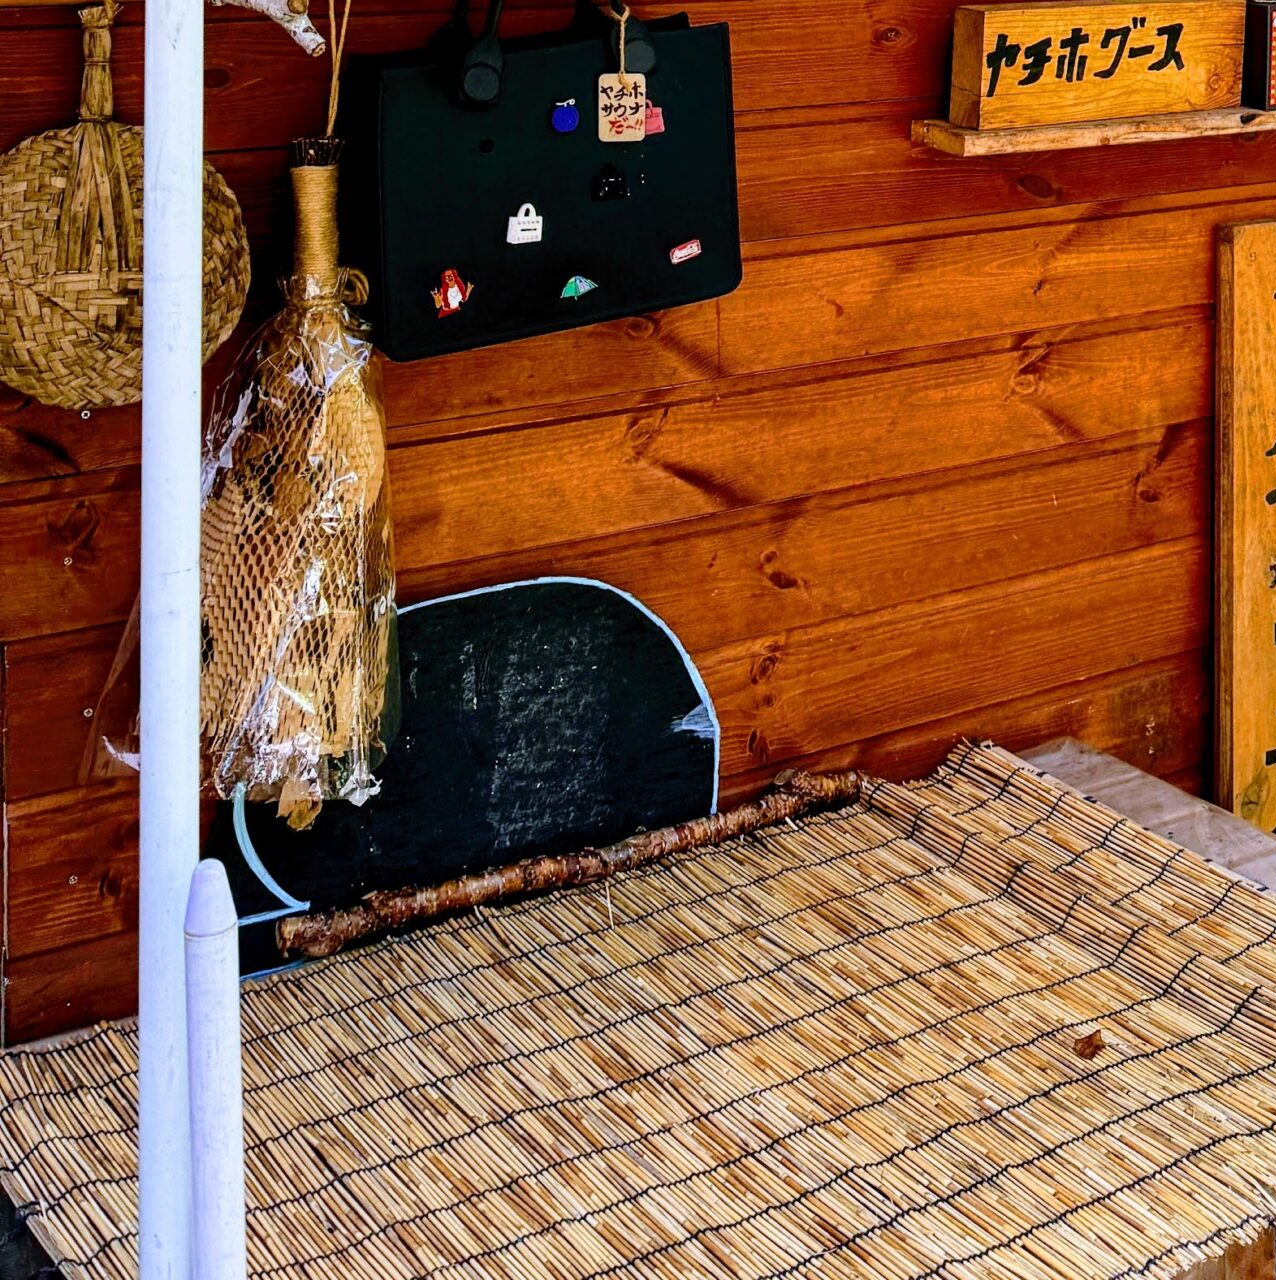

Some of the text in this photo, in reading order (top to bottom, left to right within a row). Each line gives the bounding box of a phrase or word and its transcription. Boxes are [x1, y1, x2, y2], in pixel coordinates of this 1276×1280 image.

[986, 16, 1185, 97] ヤチホグース
[600, 81, 644, 101] ヤチホ
[601, 102, 644, 118] サウナ
